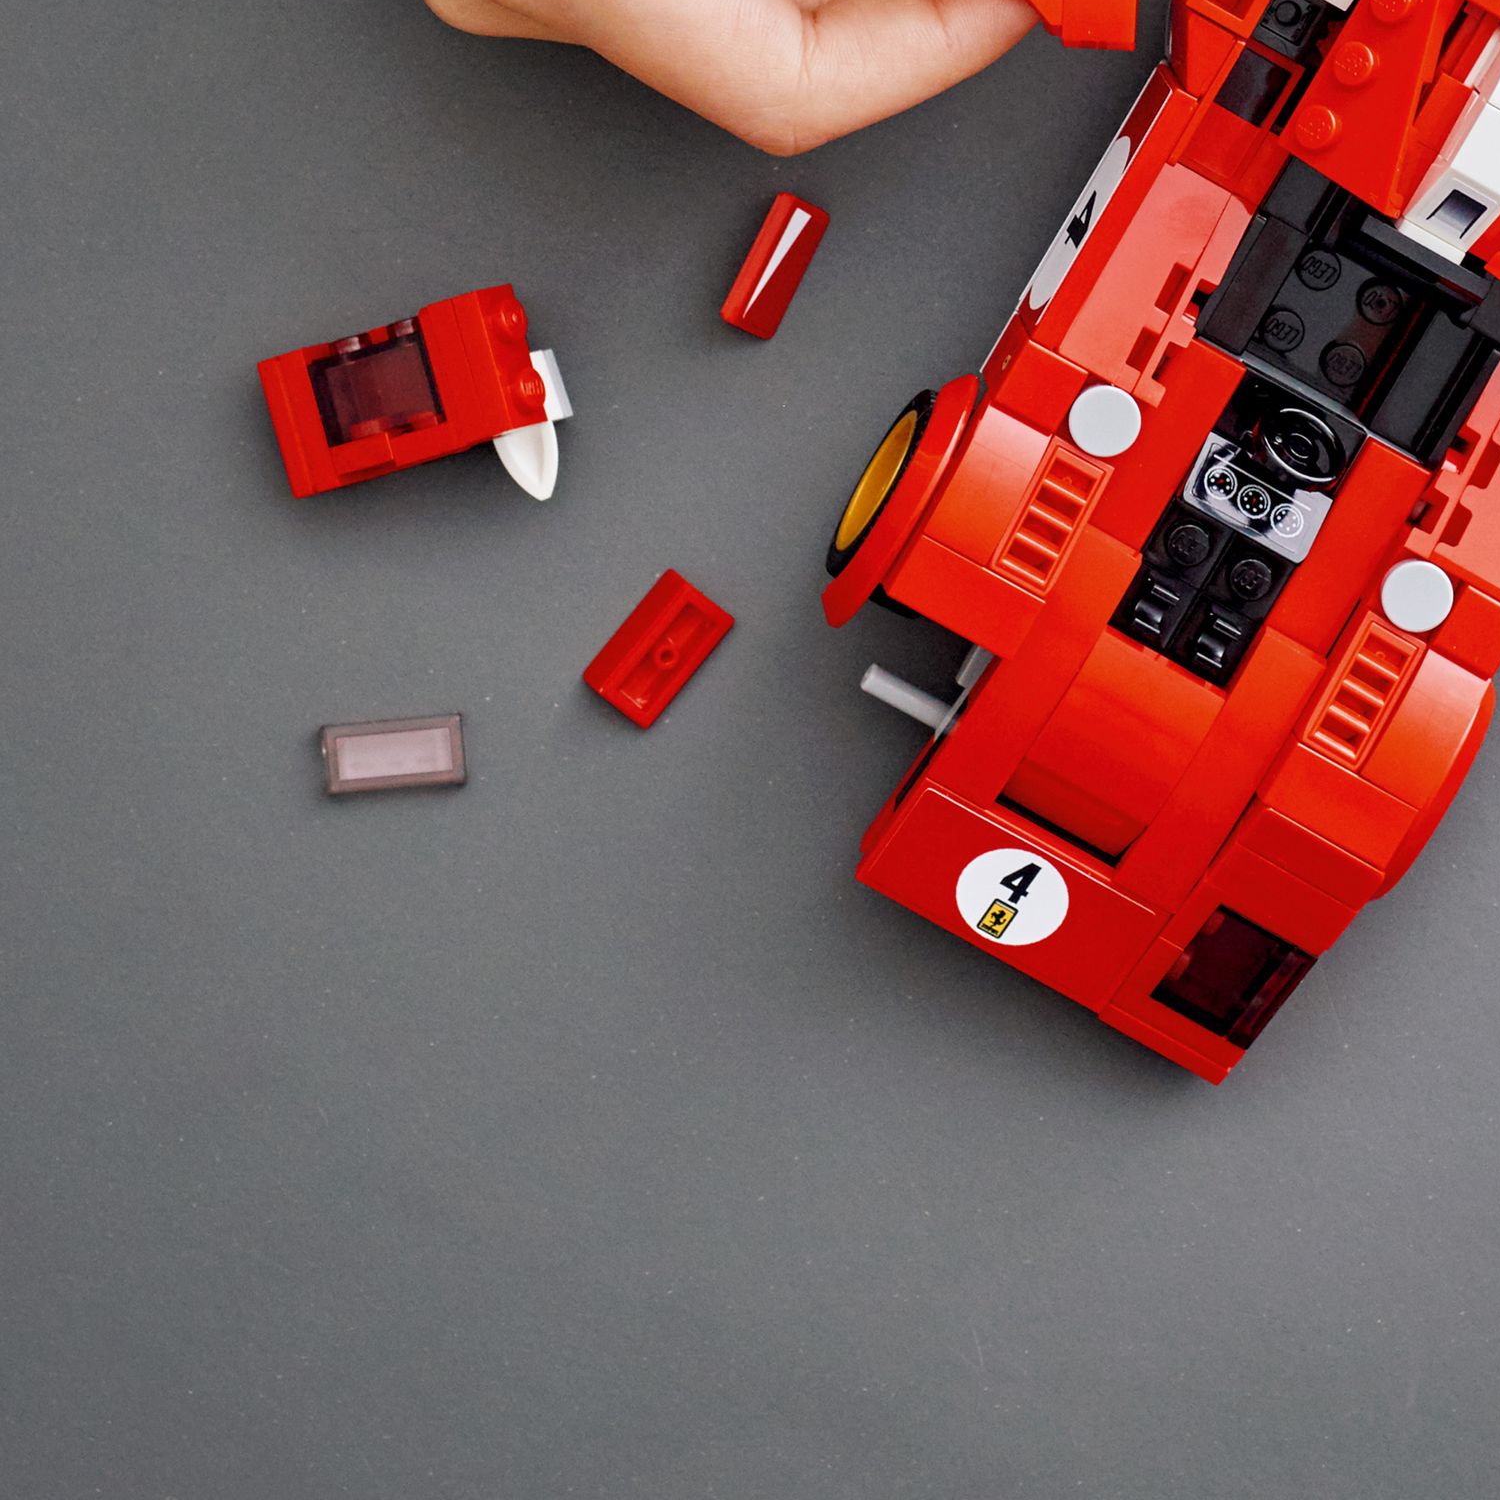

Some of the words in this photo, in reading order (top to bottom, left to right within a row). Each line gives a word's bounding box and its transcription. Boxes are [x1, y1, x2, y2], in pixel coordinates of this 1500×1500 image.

[1064, 190, 1097, 249] 4
[1302, 255, 1338, 283] LEGO
[1264, 317, 1300, 345] LEGO
[999, 862, 1042, 904] 4
